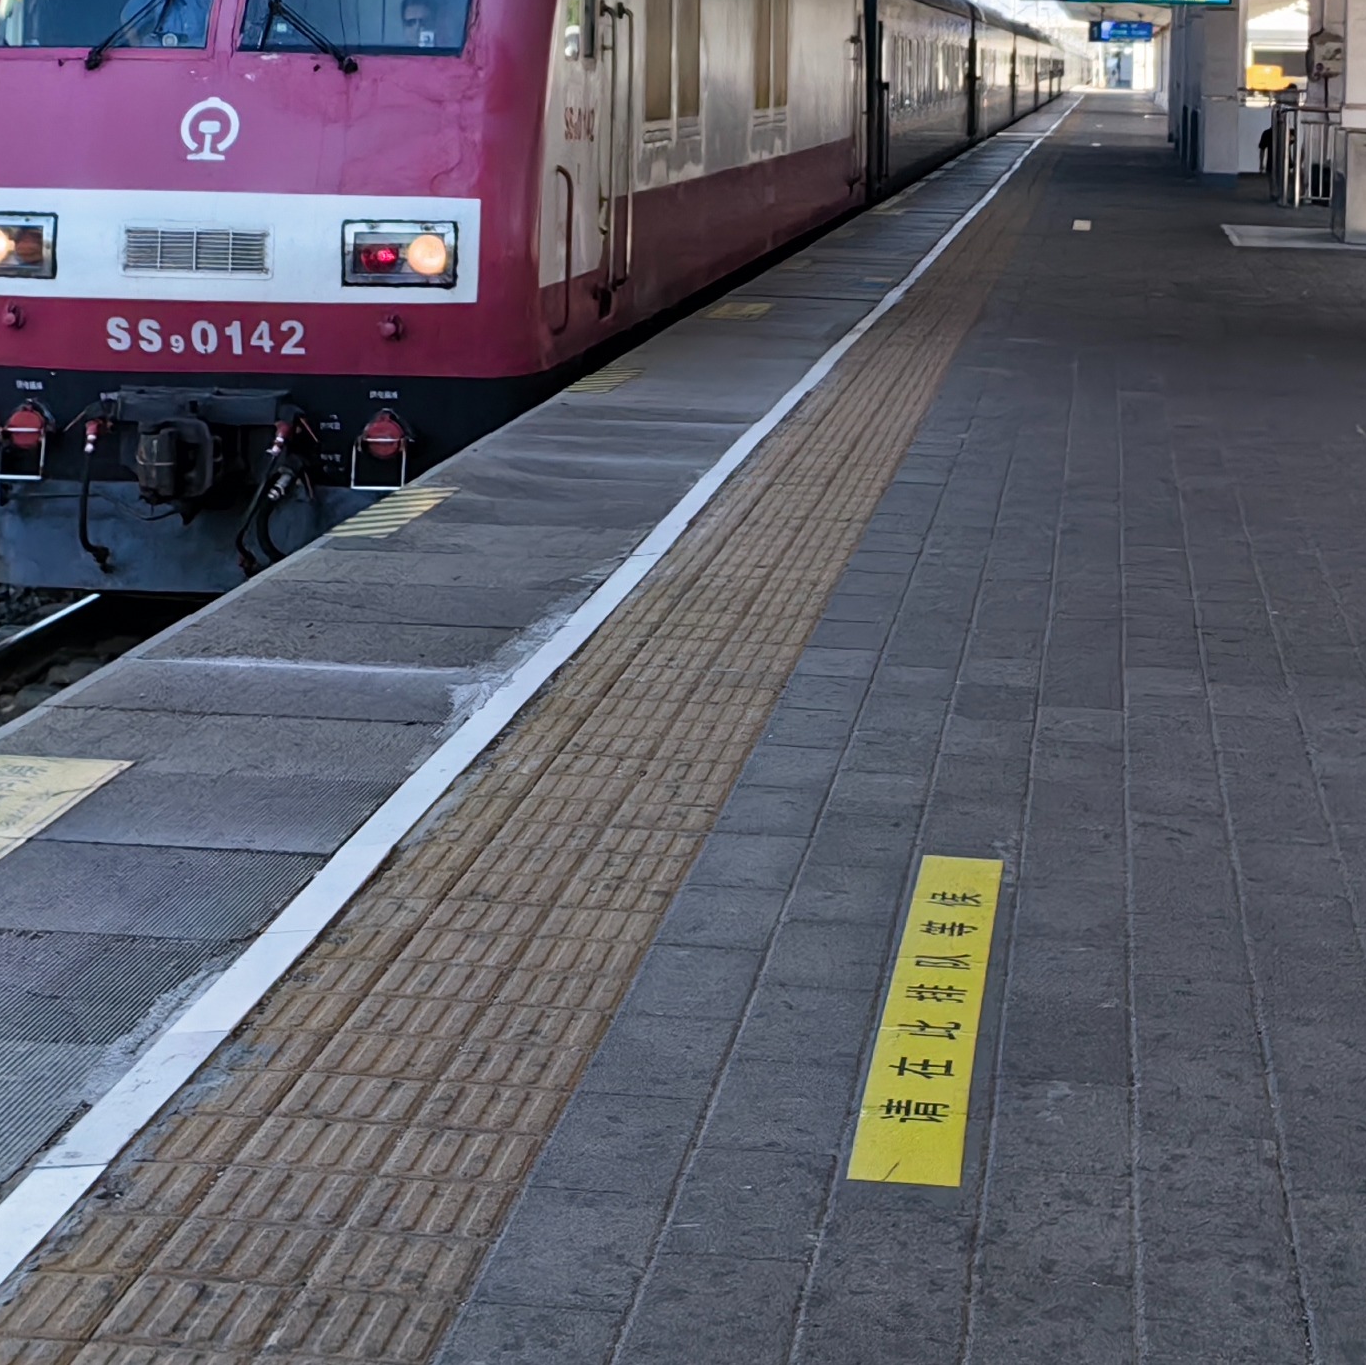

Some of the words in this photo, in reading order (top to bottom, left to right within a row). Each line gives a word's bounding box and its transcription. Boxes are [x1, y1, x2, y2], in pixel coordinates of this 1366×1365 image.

[879, 891, 984, 1124] 请在此排队等候
